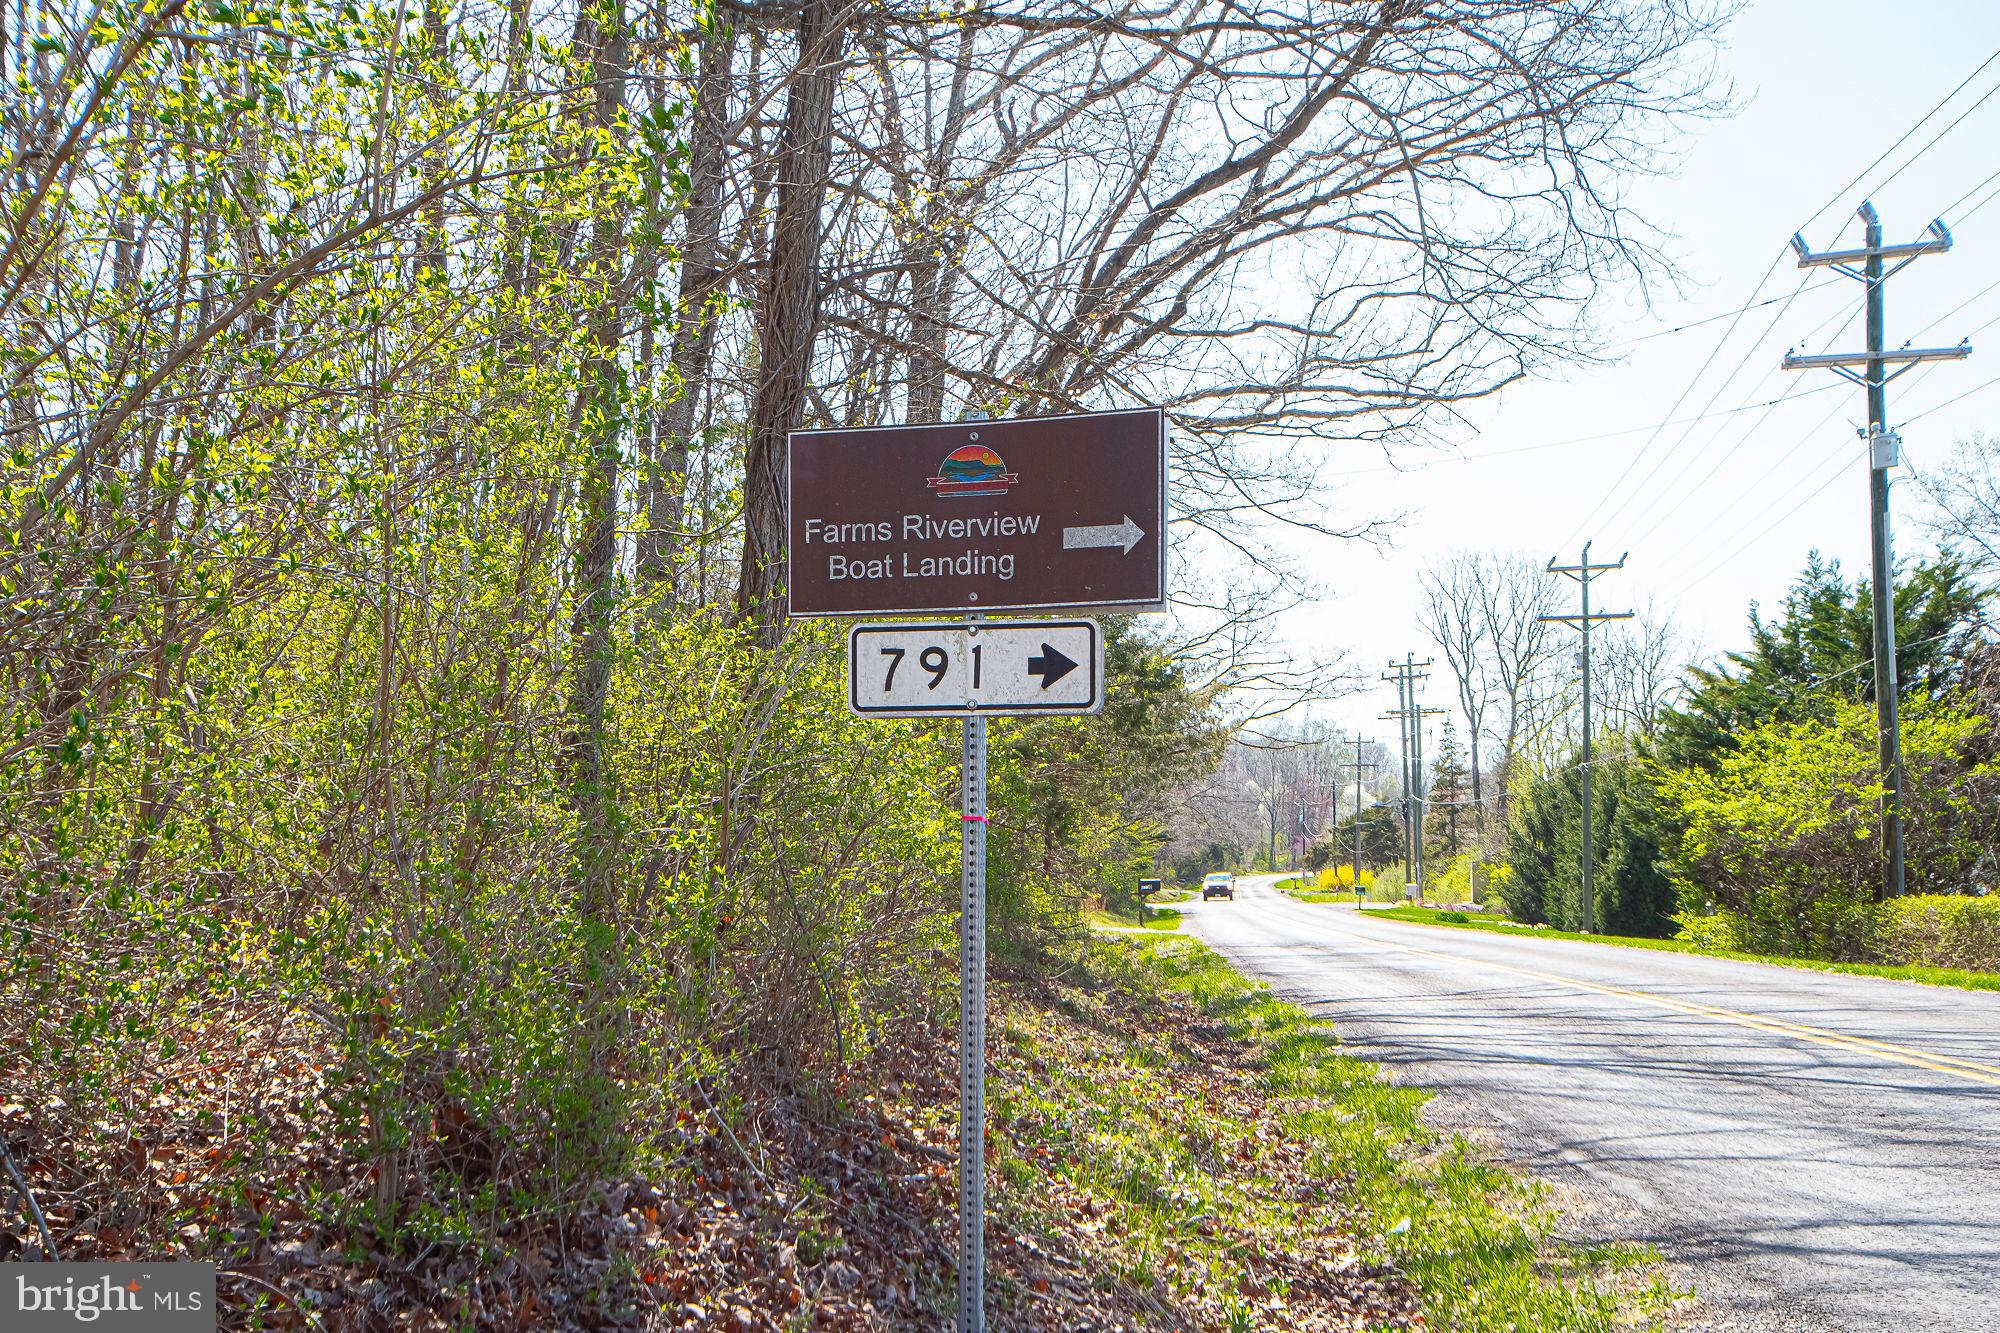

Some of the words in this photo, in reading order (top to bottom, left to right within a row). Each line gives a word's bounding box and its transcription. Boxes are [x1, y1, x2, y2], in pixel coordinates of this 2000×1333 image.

[805, 518, 892, 543] Farms
[903, 511, 1040, 540] Riverview
[828, 554, 893, 580] Boat
[902, 549, 1015, 580] Landing
[880, 644, 982, 692] 791
